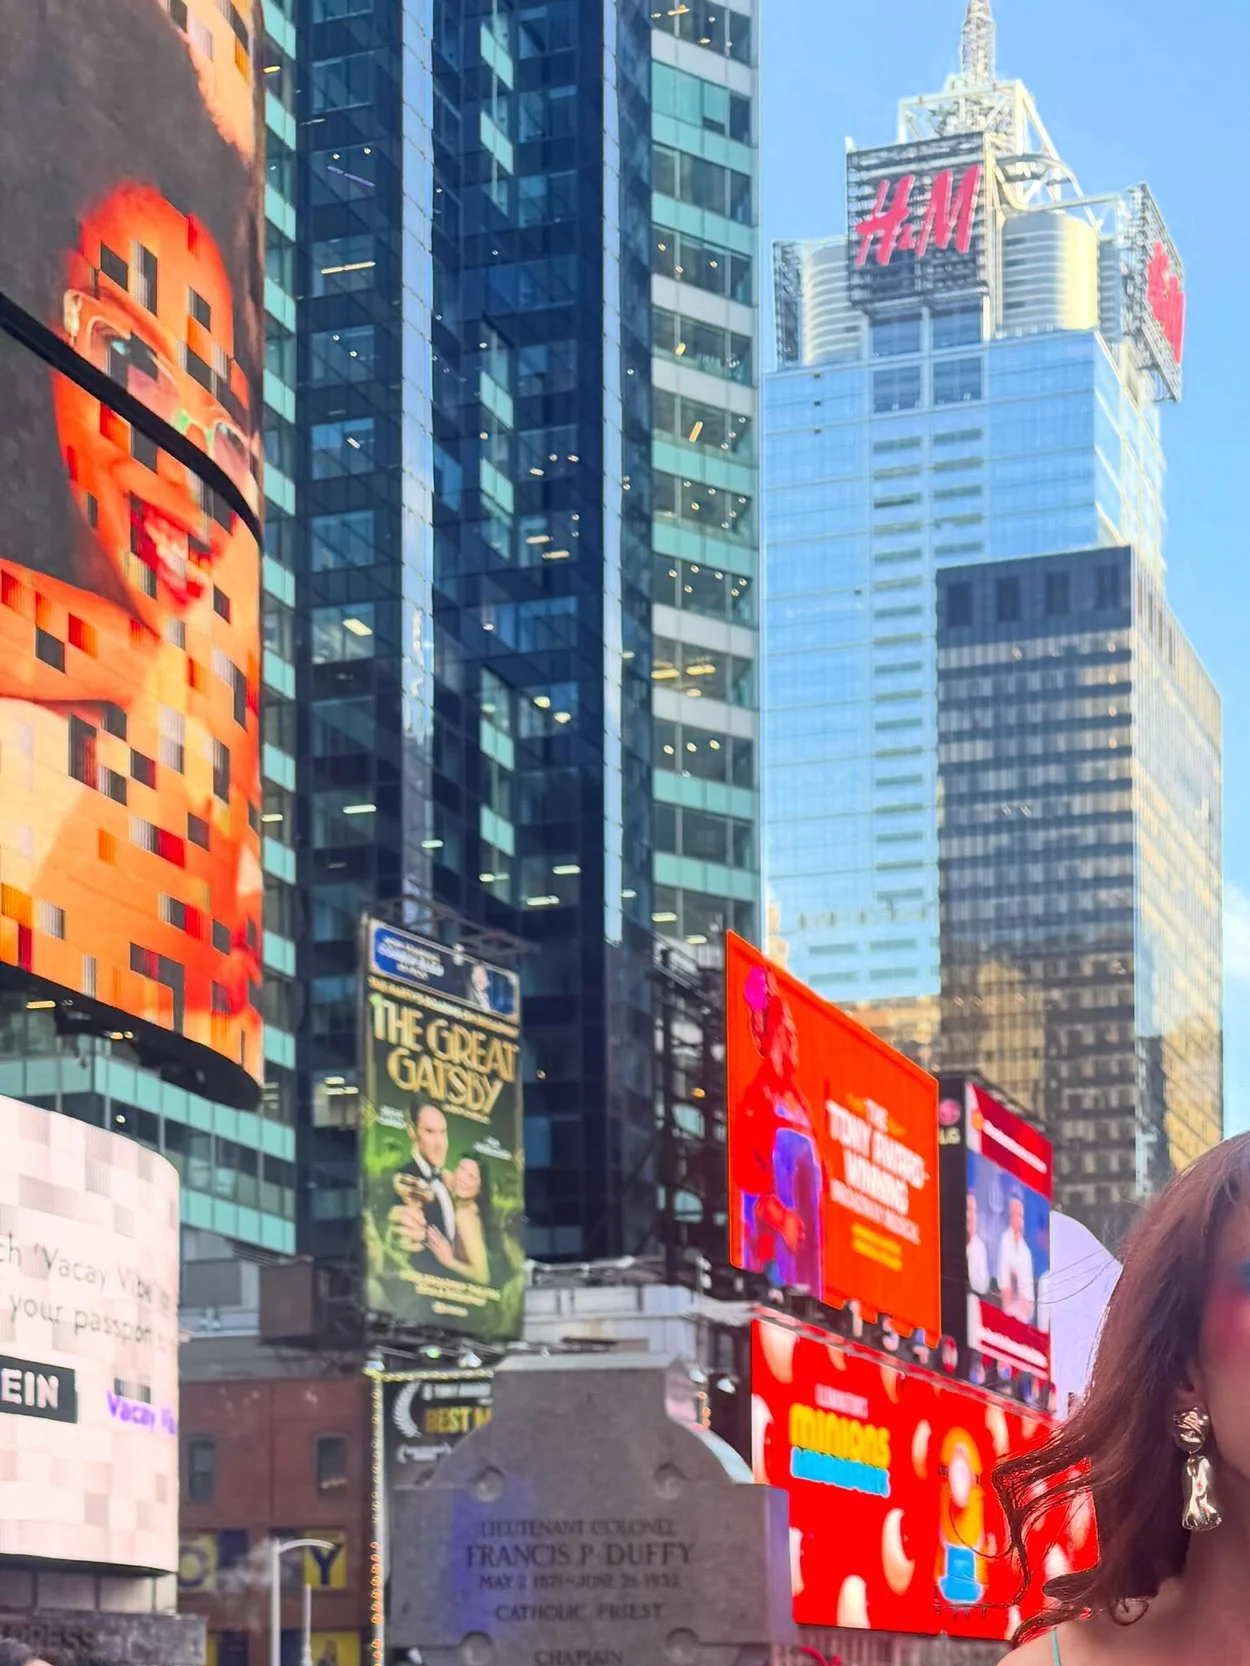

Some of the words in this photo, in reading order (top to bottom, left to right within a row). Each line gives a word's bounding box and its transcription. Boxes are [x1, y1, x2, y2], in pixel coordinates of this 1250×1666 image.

[855, 164, 981, 268] H&M
[372, 994, 424, 1052] THE
[427, 1017, 520, 1084] GREAT
[388, 1047, 505, 1116] GATSBY
[9, 1294, 65, 1324] your
[425, 1406, 472, 1434] BEST
[481, 1518, 585, 1538] LIEUTENANT
[590, 1518, 677, 1538] COLONEL
[465, 1543, 571, 1568] FRANCIS
[580, 1543, 595, 1567] P
[607, 1543, 696, 1567] DUFFY
[479, 1573, 512, 1591] MAY
[495, 1603, 584, 1623] CATHOLIC
[597, 1602, 665, 1621] PRIEST
